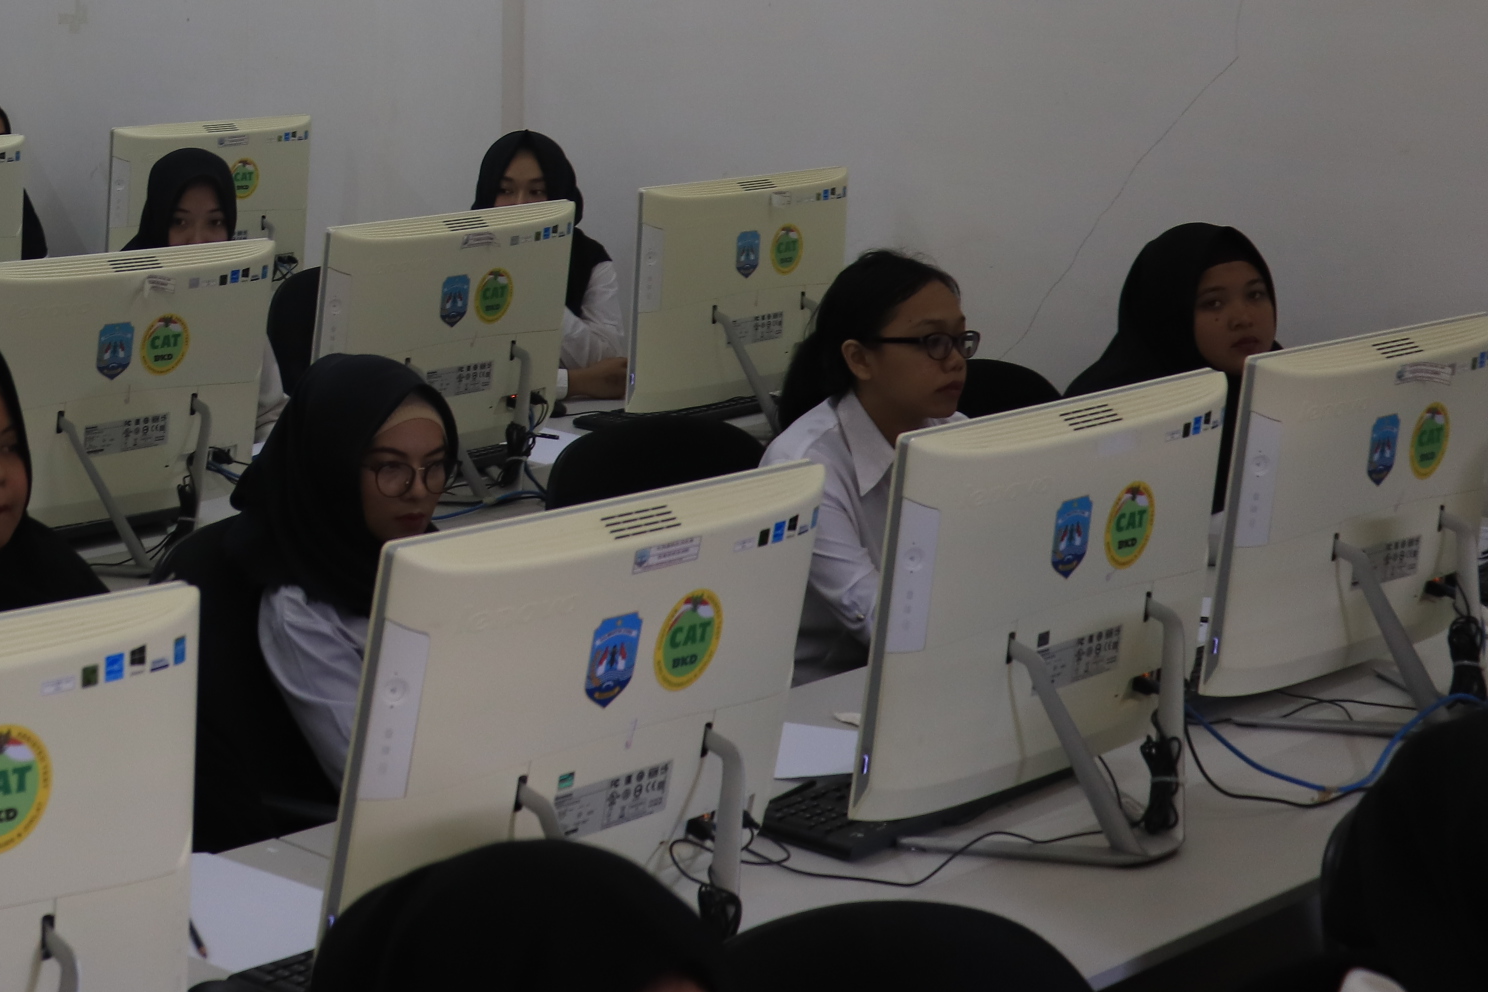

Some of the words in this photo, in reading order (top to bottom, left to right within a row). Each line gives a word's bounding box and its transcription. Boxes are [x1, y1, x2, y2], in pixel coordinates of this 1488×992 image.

[234, 172, 254, 182] CAT
[776, 239, 798, 254] CAT
[482, 285, 507, 300] CAT
[150, 333, 181, 349] CAT
[1417, 425, 1444, 447] CAT
[1115, 509, 1147, 533] CAT
[669, 620, 711, 649] CAT
[672, 653, 698, 669] BKD
